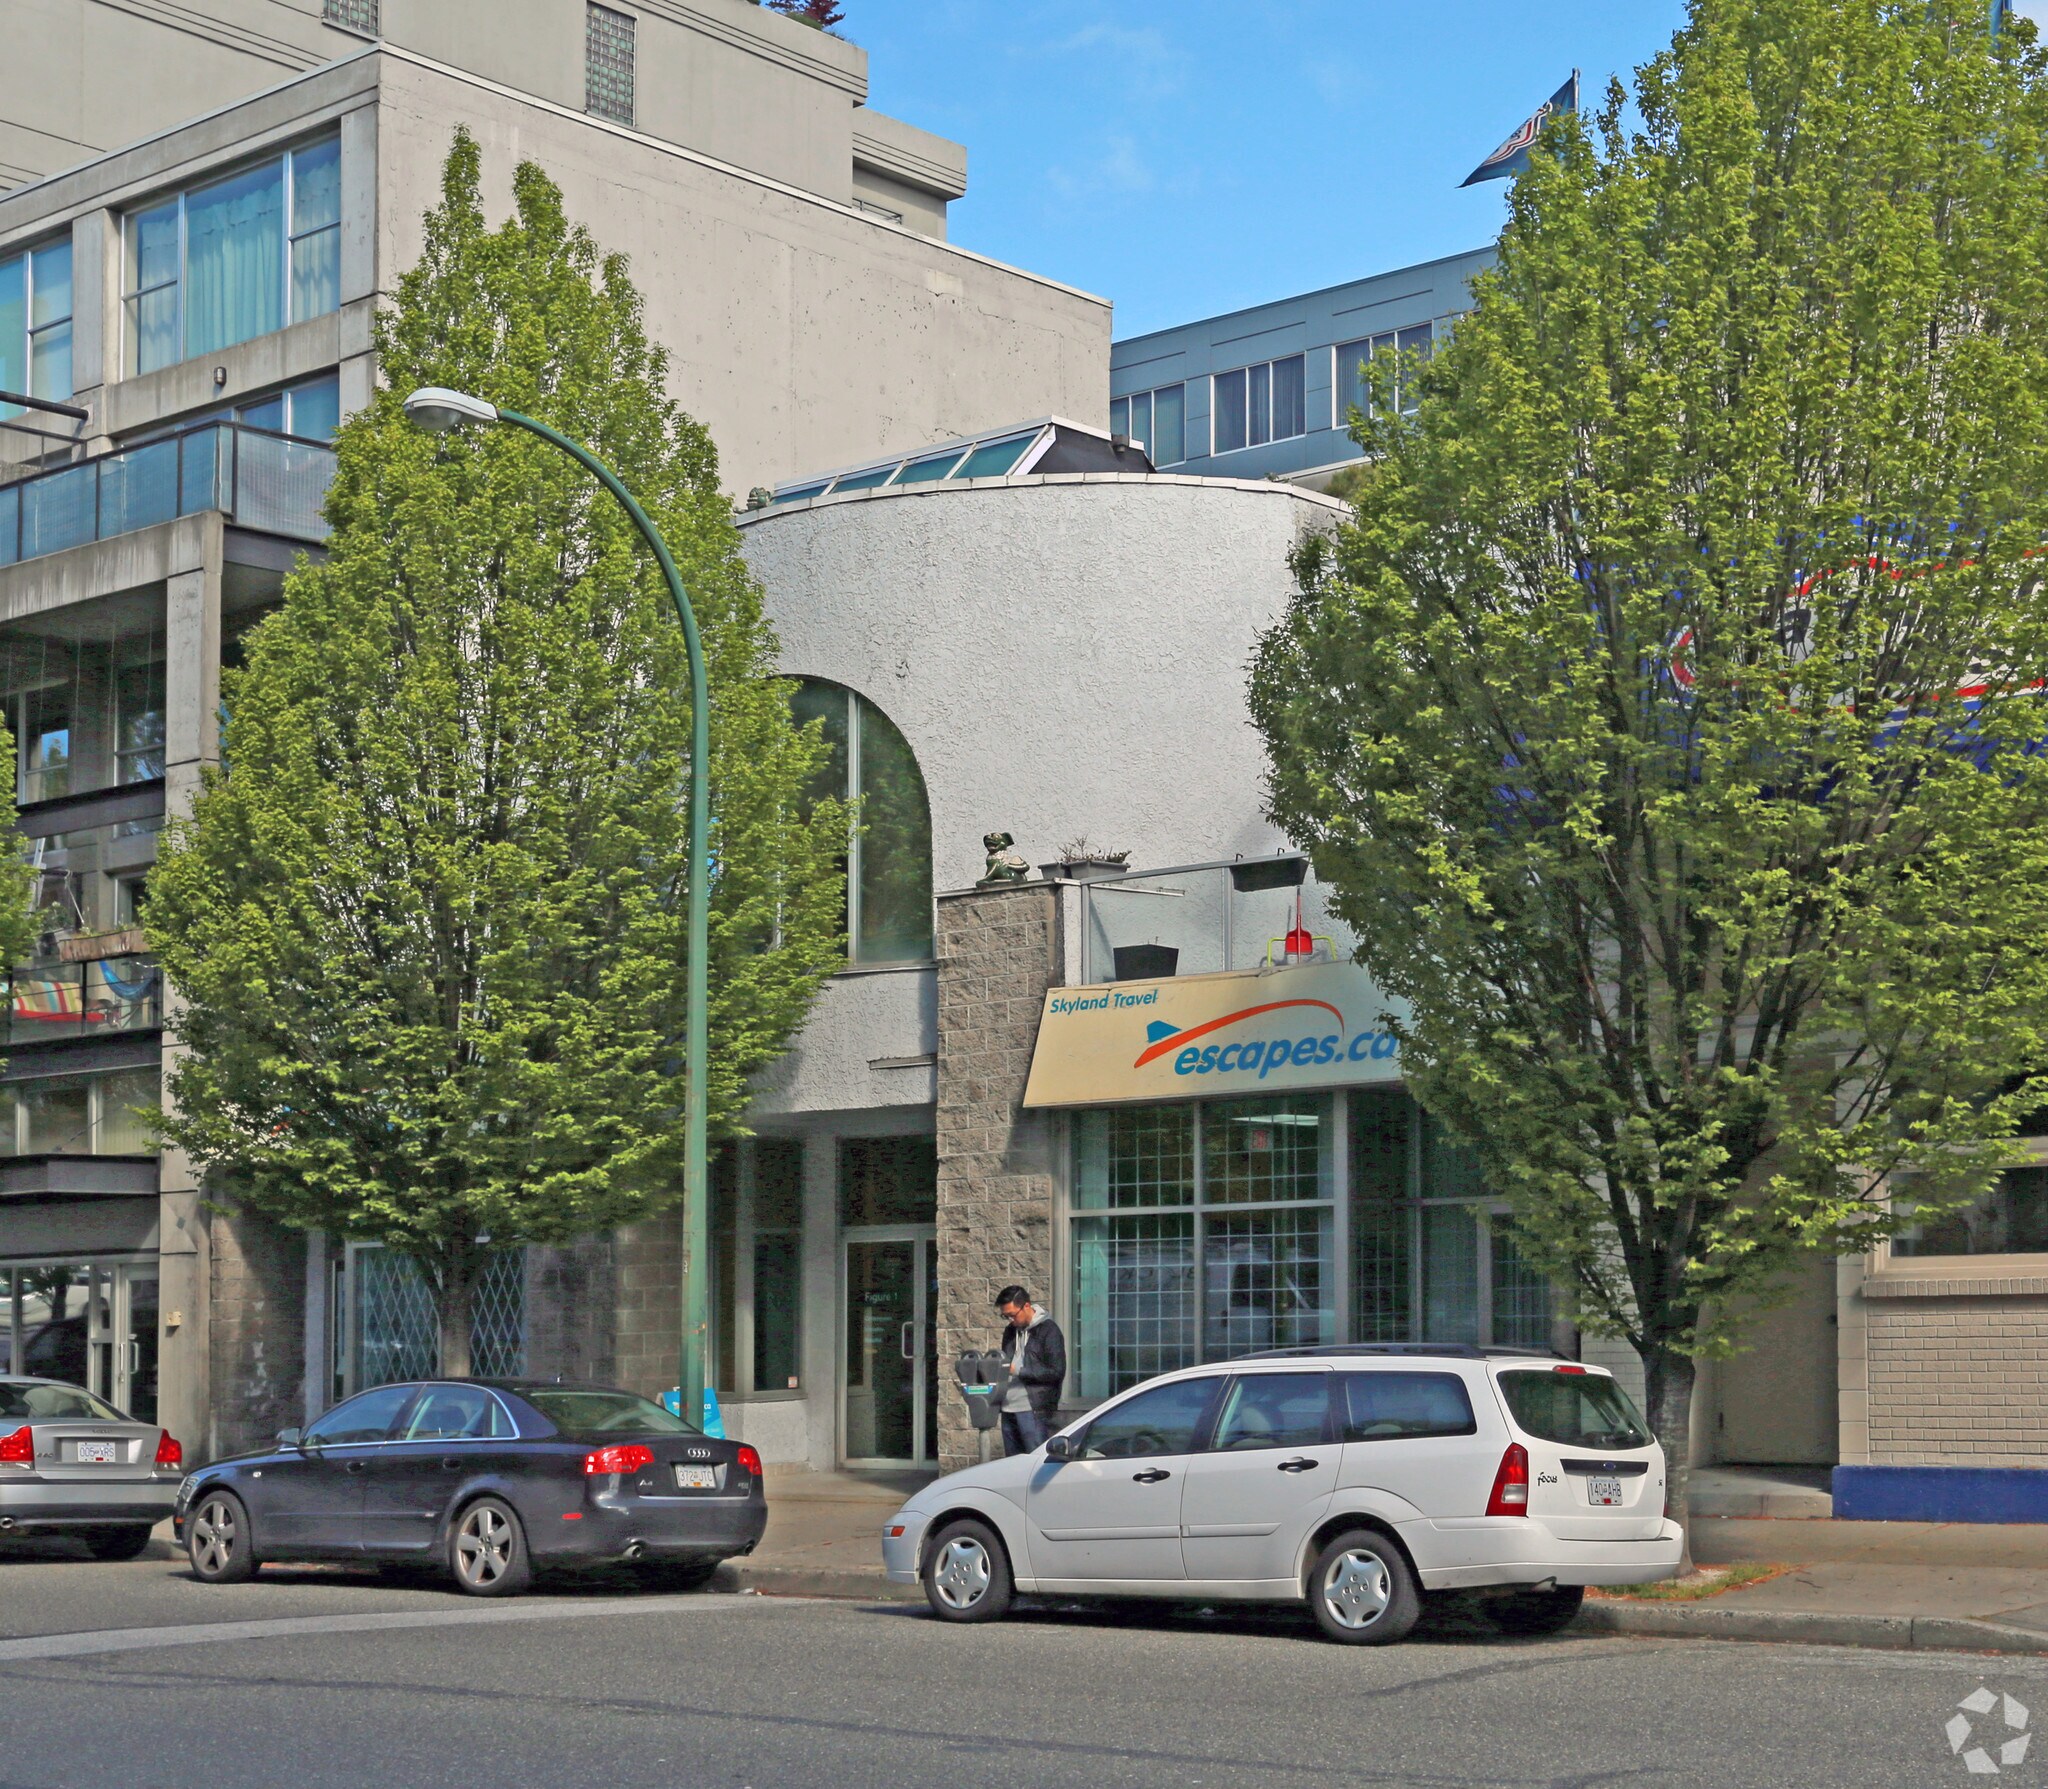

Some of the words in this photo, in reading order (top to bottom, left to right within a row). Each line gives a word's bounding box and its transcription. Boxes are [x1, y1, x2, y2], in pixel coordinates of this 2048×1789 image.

[1050, 994, 1110, 1016] Skyland
[1114, 989, 1159, 1008] Travel
[1174, 1032, 1398, 1080] escapes.ca
[865, 1292, 891, 1304] Figure
